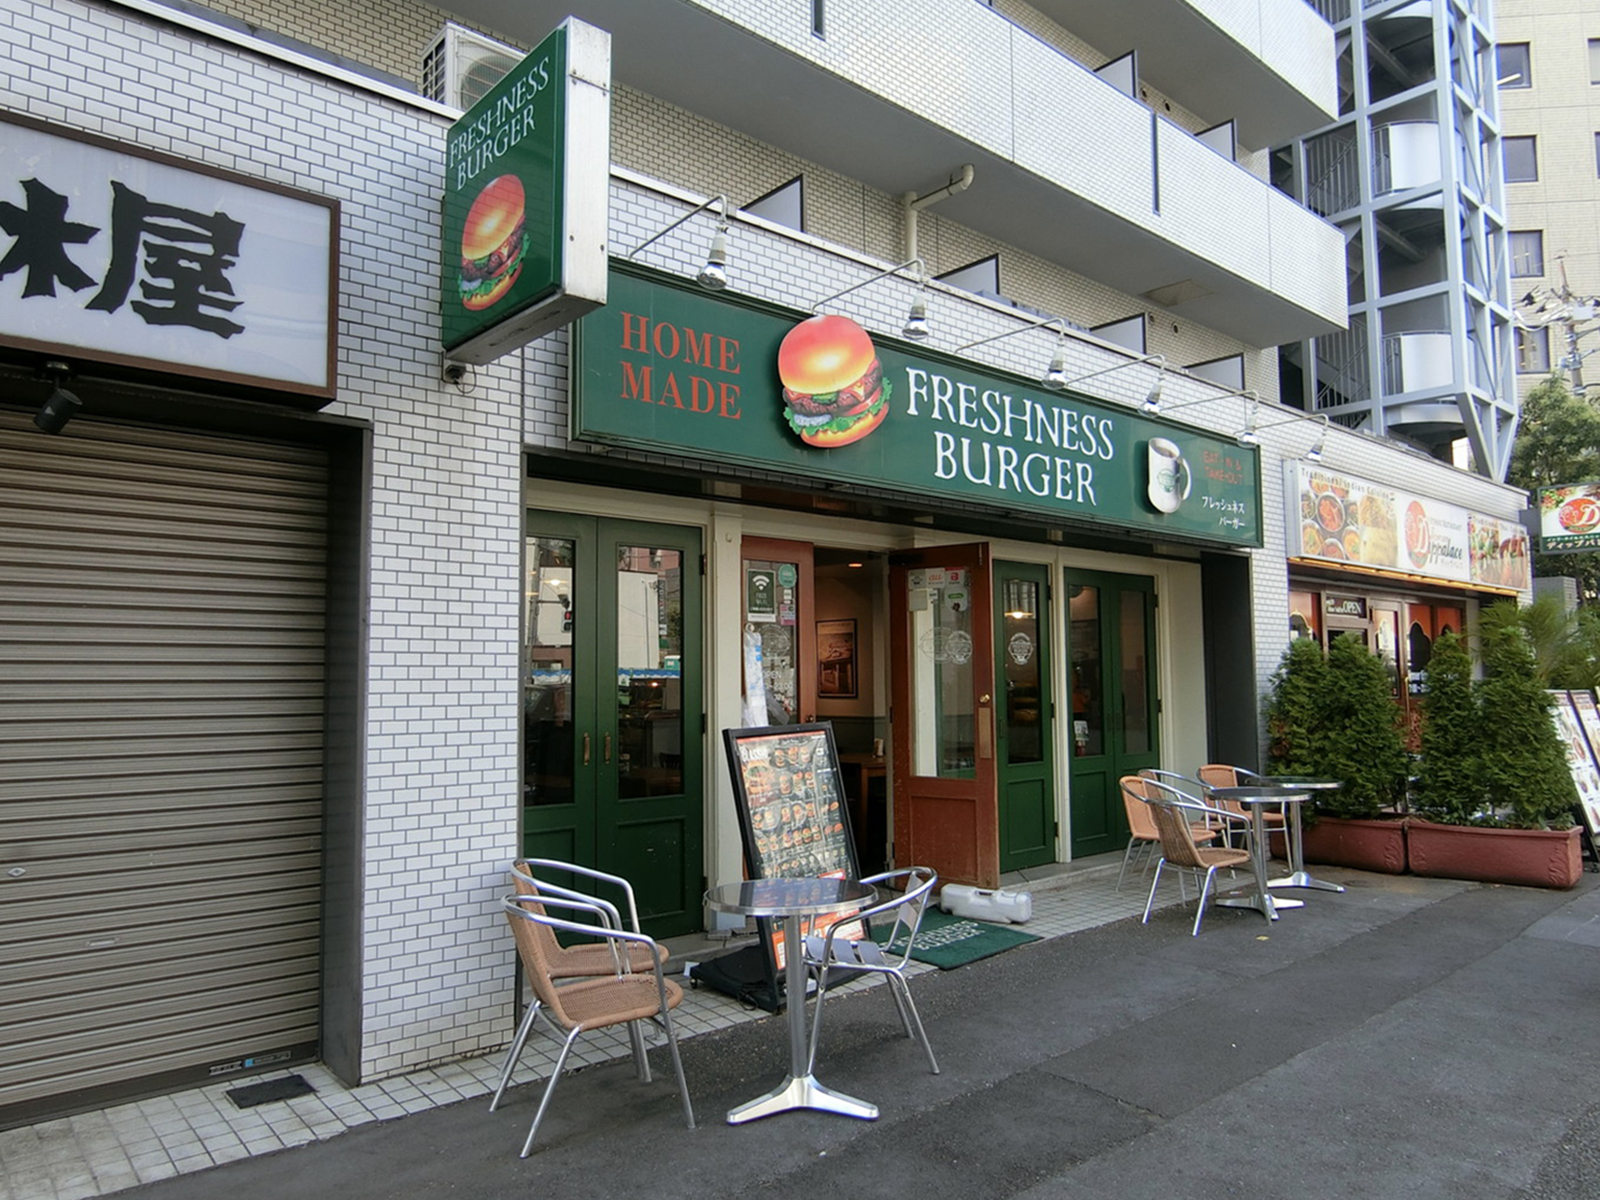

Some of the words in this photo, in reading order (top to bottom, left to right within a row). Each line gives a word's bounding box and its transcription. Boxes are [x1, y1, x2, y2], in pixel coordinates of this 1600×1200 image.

[450, 56, 550, 169] FRESHNESS
[457, 104, 536, 191] BURGER
[620, 311, 742, 374] HOME
[620, 361, 742, 420] MADE
[906, 366, 1114, 461] FRESHNESS
[934, 430, 1097, 506] BURGER
[1201, 496, 1246, 514] フレッシュネス
[1219, 517, 1246, 530] バーガー
[1342, 600, 1362, 614] OPEN
